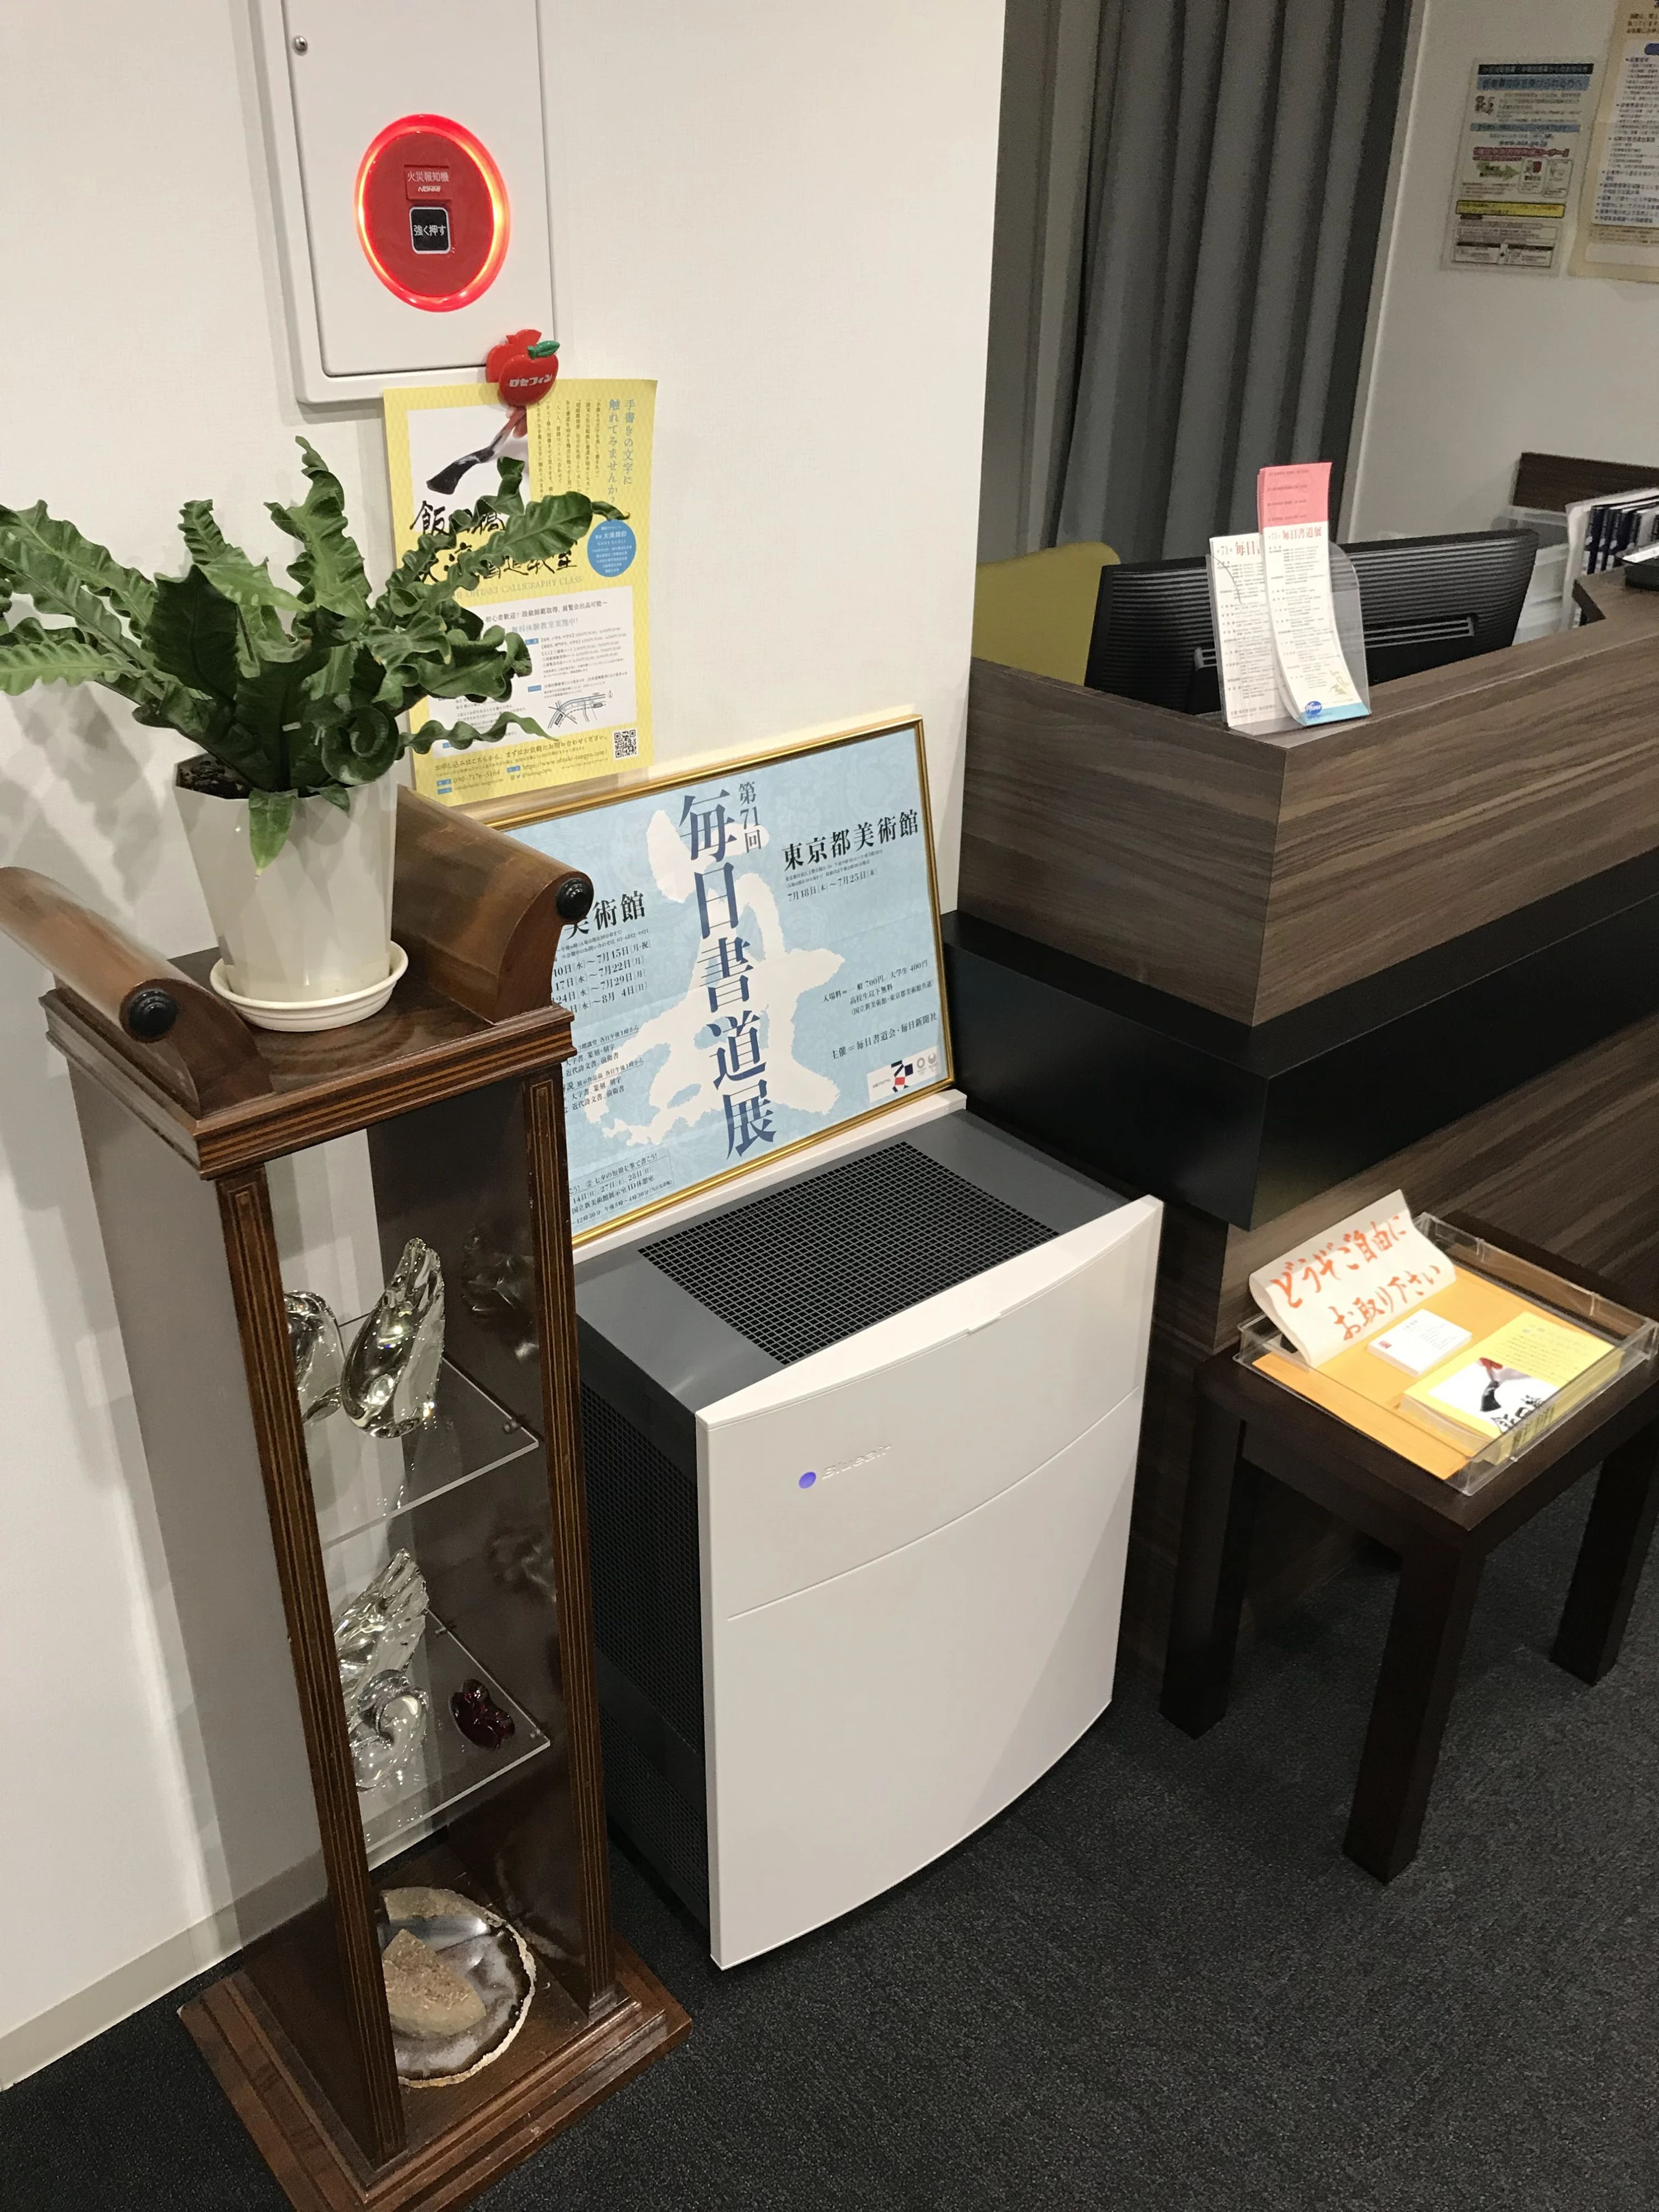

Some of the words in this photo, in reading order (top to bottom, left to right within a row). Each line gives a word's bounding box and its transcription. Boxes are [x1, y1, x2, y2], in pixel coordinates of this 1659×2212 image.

[408, 171, 449, 182] 火災報知機
[414, 225, 446, 236] 強く押す
[509, 374, 552, 388] ロセフィン
[623, 399, 635, 485] 手書きの文字に
[410, 500, 505, 536] 飯橋
[1282, 526, 1322, 540] 毎日書道展
[1235, 540, 1260, 556] 毎日
[466, 587, 498, 598] OHTAKI
[502, 579, 556, 593] CALLIGRAPHY
[559, 575, 583, 585] CLASS
[738, 782, 762, 853] 第71回
[781, 808, 918, 872] 東京都美術館
[679, 789, 778, 1161] 毎日書道展
[850, 983, 893, 1005] 高校生以下無料
[1272, 1214, 1406, 1309] どうぞご自由に
[1328, 1265, 1442, 1340] お取り下さい
